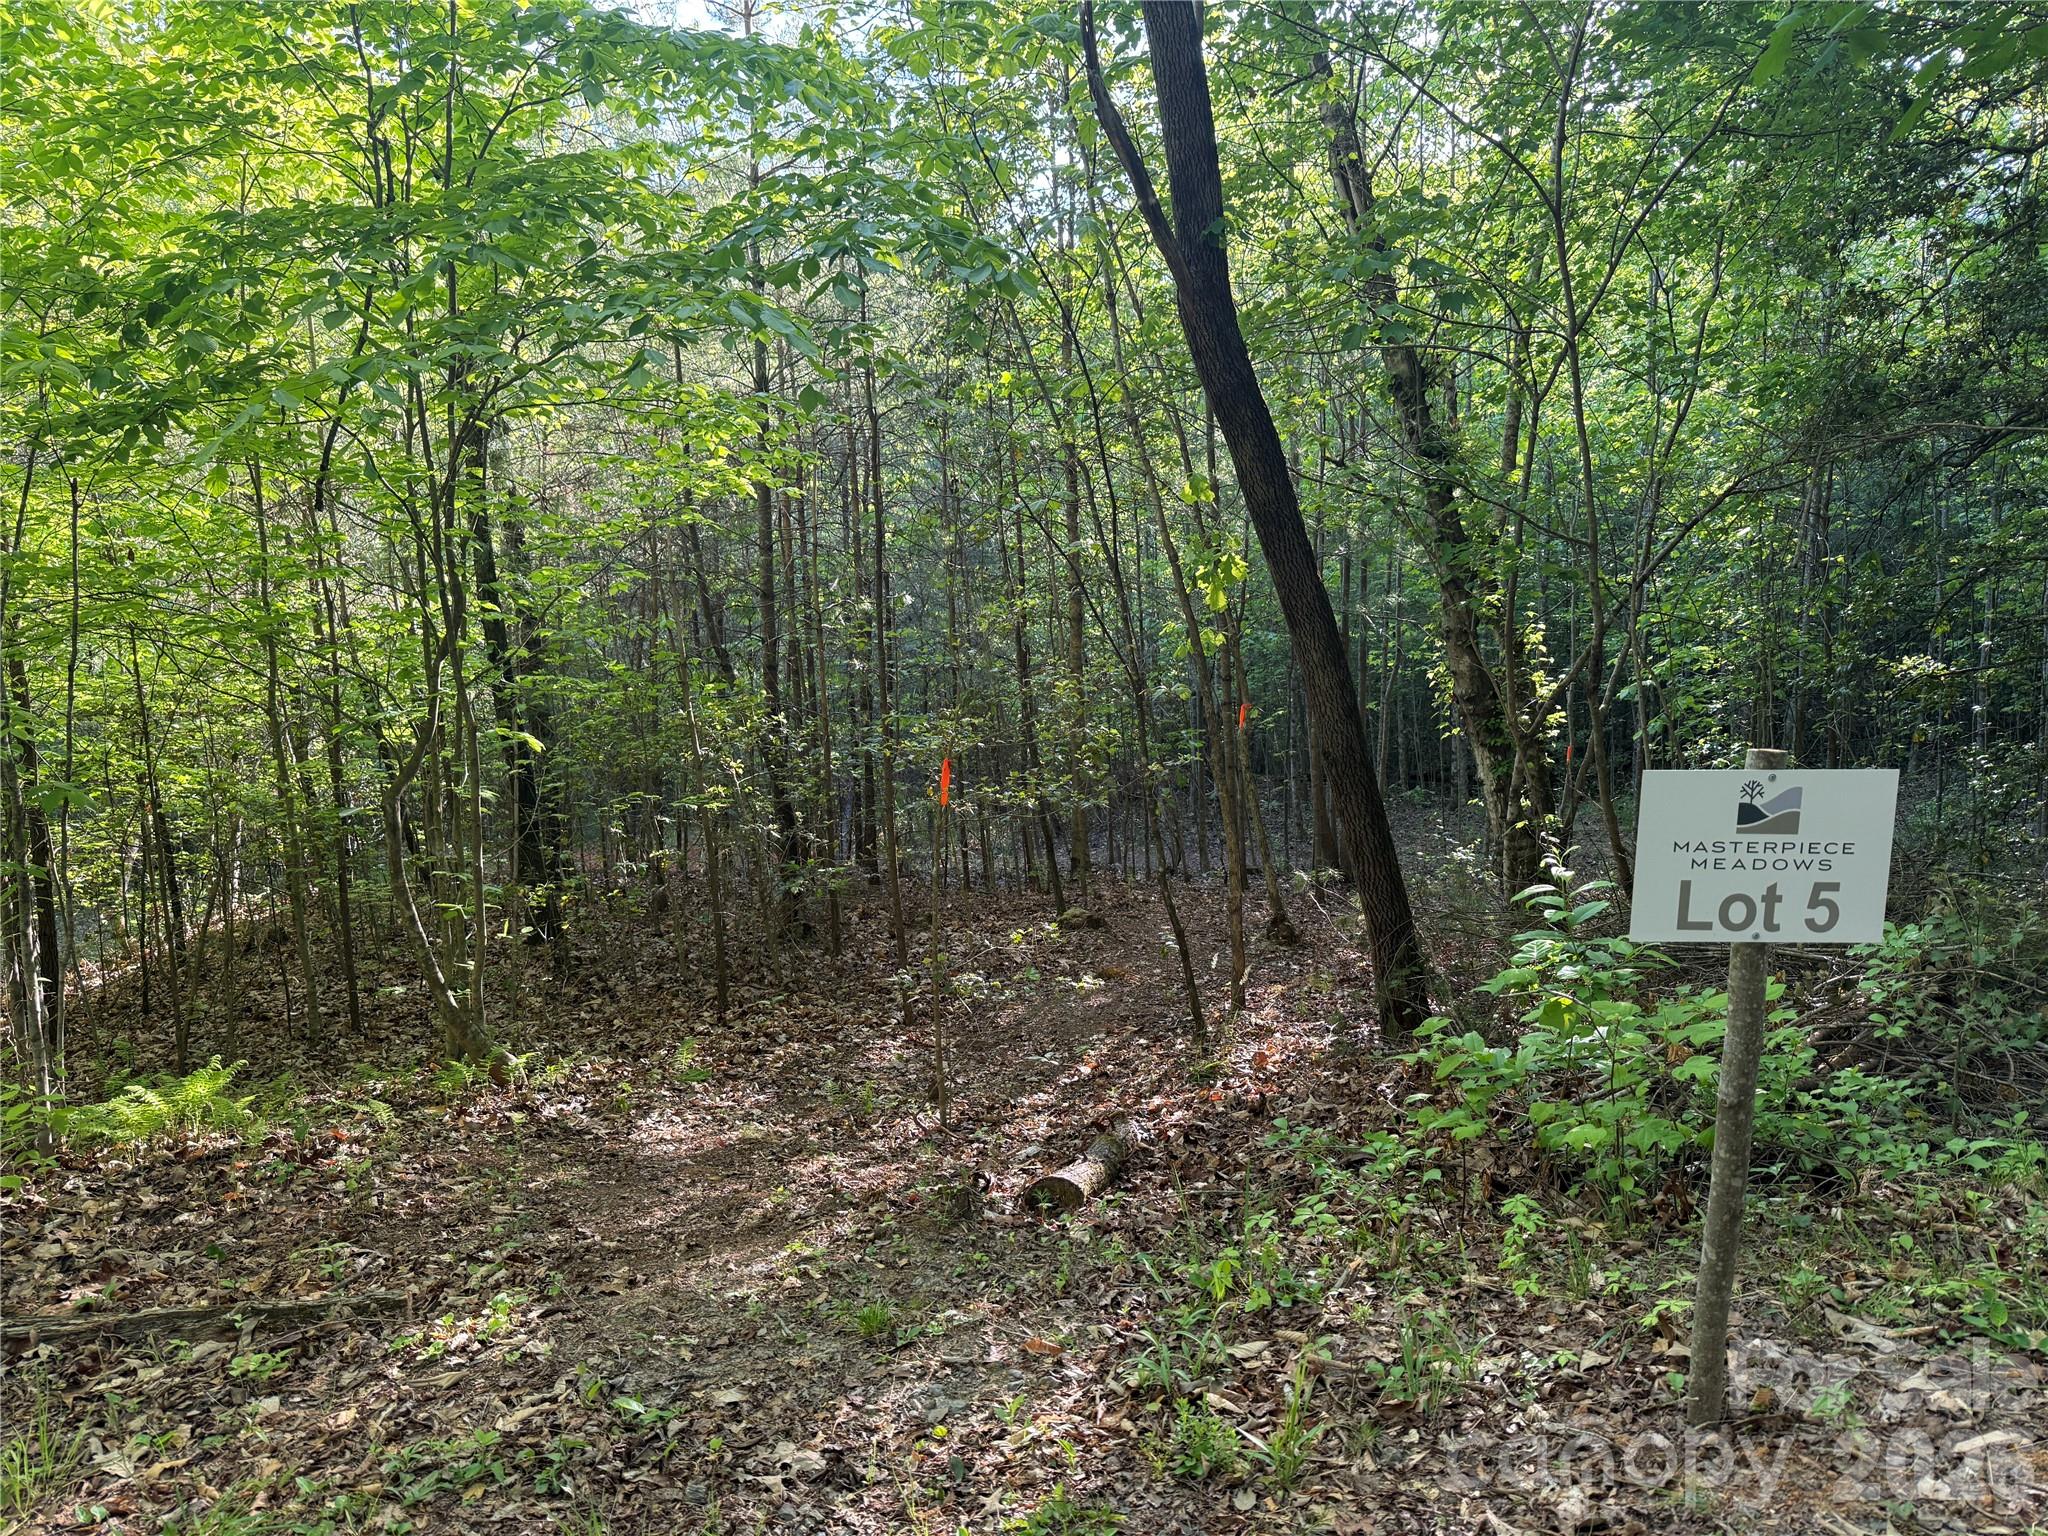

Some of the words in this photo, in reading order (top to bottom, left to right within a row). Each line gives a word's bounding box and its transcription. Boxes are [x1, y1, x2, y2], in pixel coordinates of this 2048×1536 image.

[1673, 841, 1855, 855] MASTERPIECE
[1691, 858, 1833, 871] MEADOWS
[1676, 880, 1783, 932] Lot
[1804, 881, 1841, 933] 5
